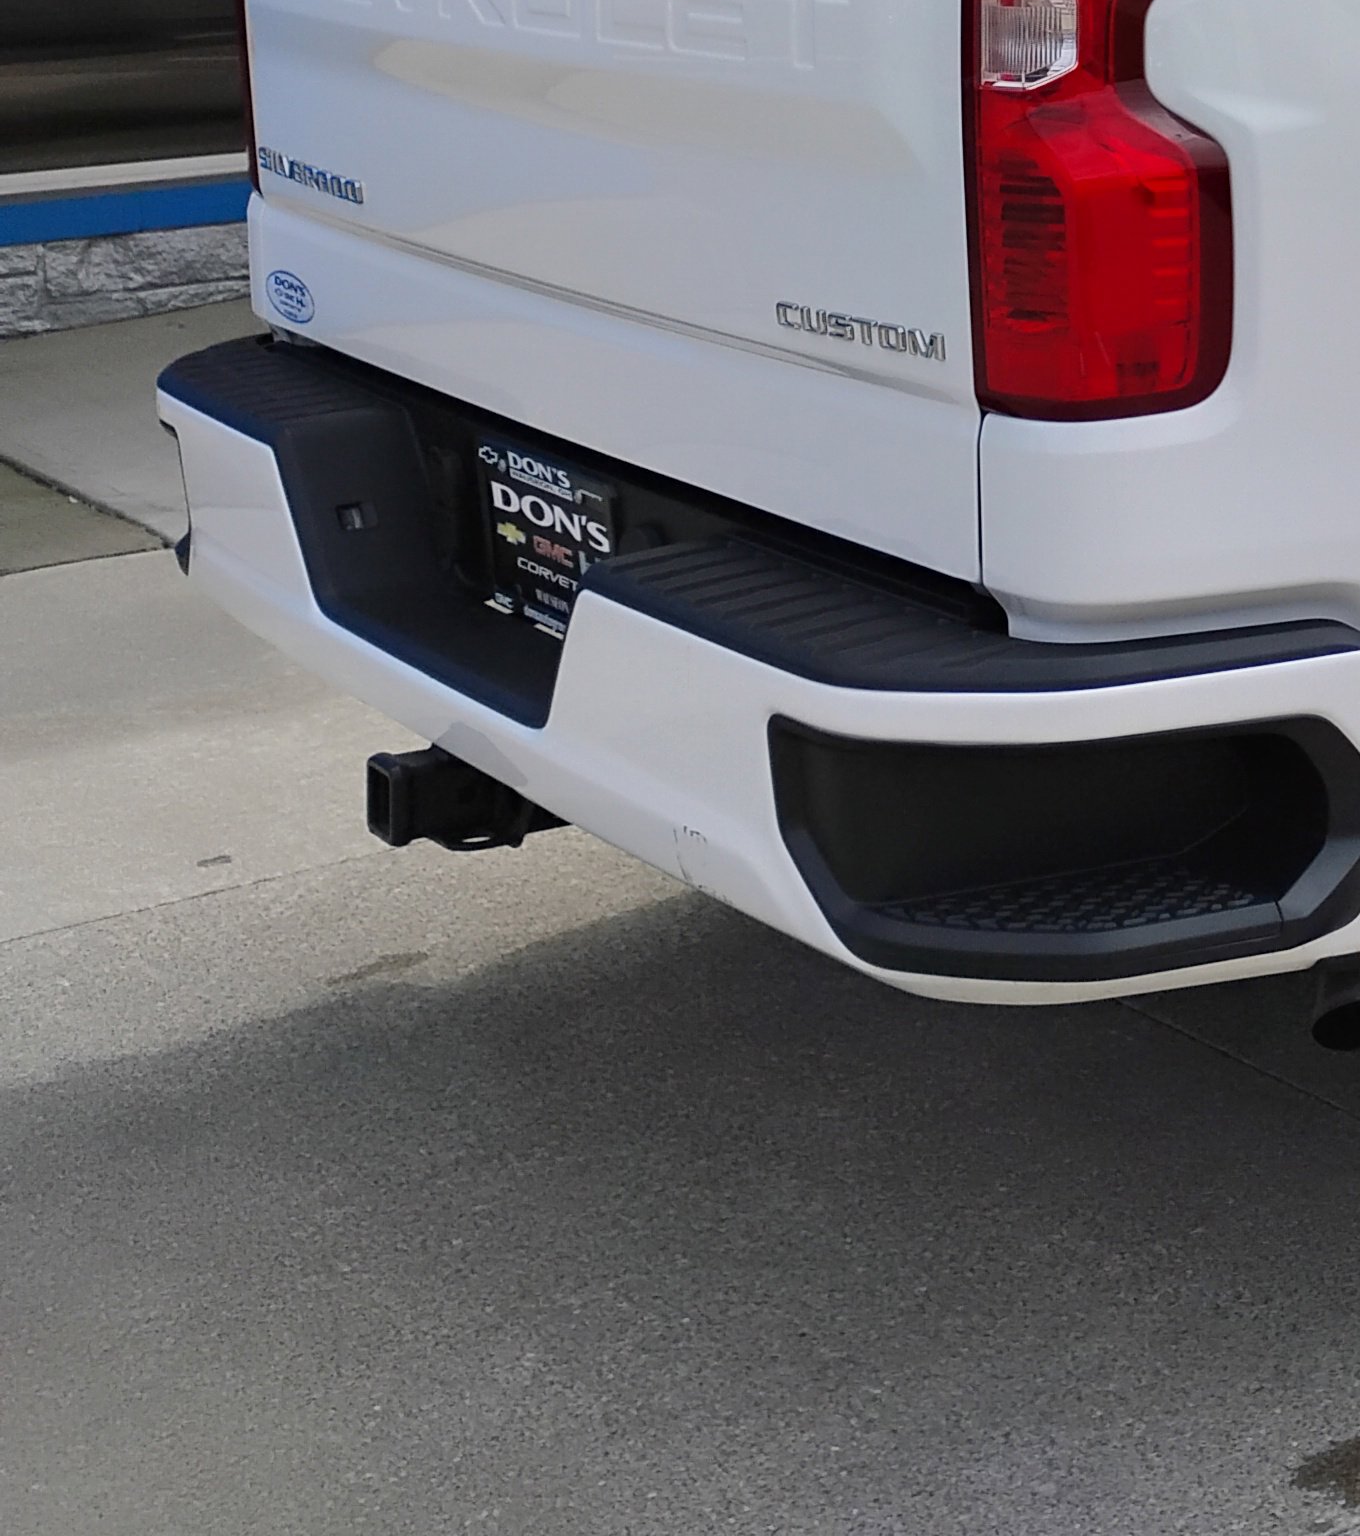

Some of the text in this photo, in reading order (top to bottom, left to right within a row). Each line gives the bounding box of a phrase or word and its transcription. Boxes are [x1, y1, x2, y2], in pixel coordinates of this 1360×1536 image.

[258, 146, 364, 205] SILVERADO
[776, 300, 946, 361] CUSTOM
[507, 450, 571, 488] DON'S
[491, 480, 611, 553] DON'S
[517, 557, 579, 591] CORVET
[532, 534, 574, 568] GMC
